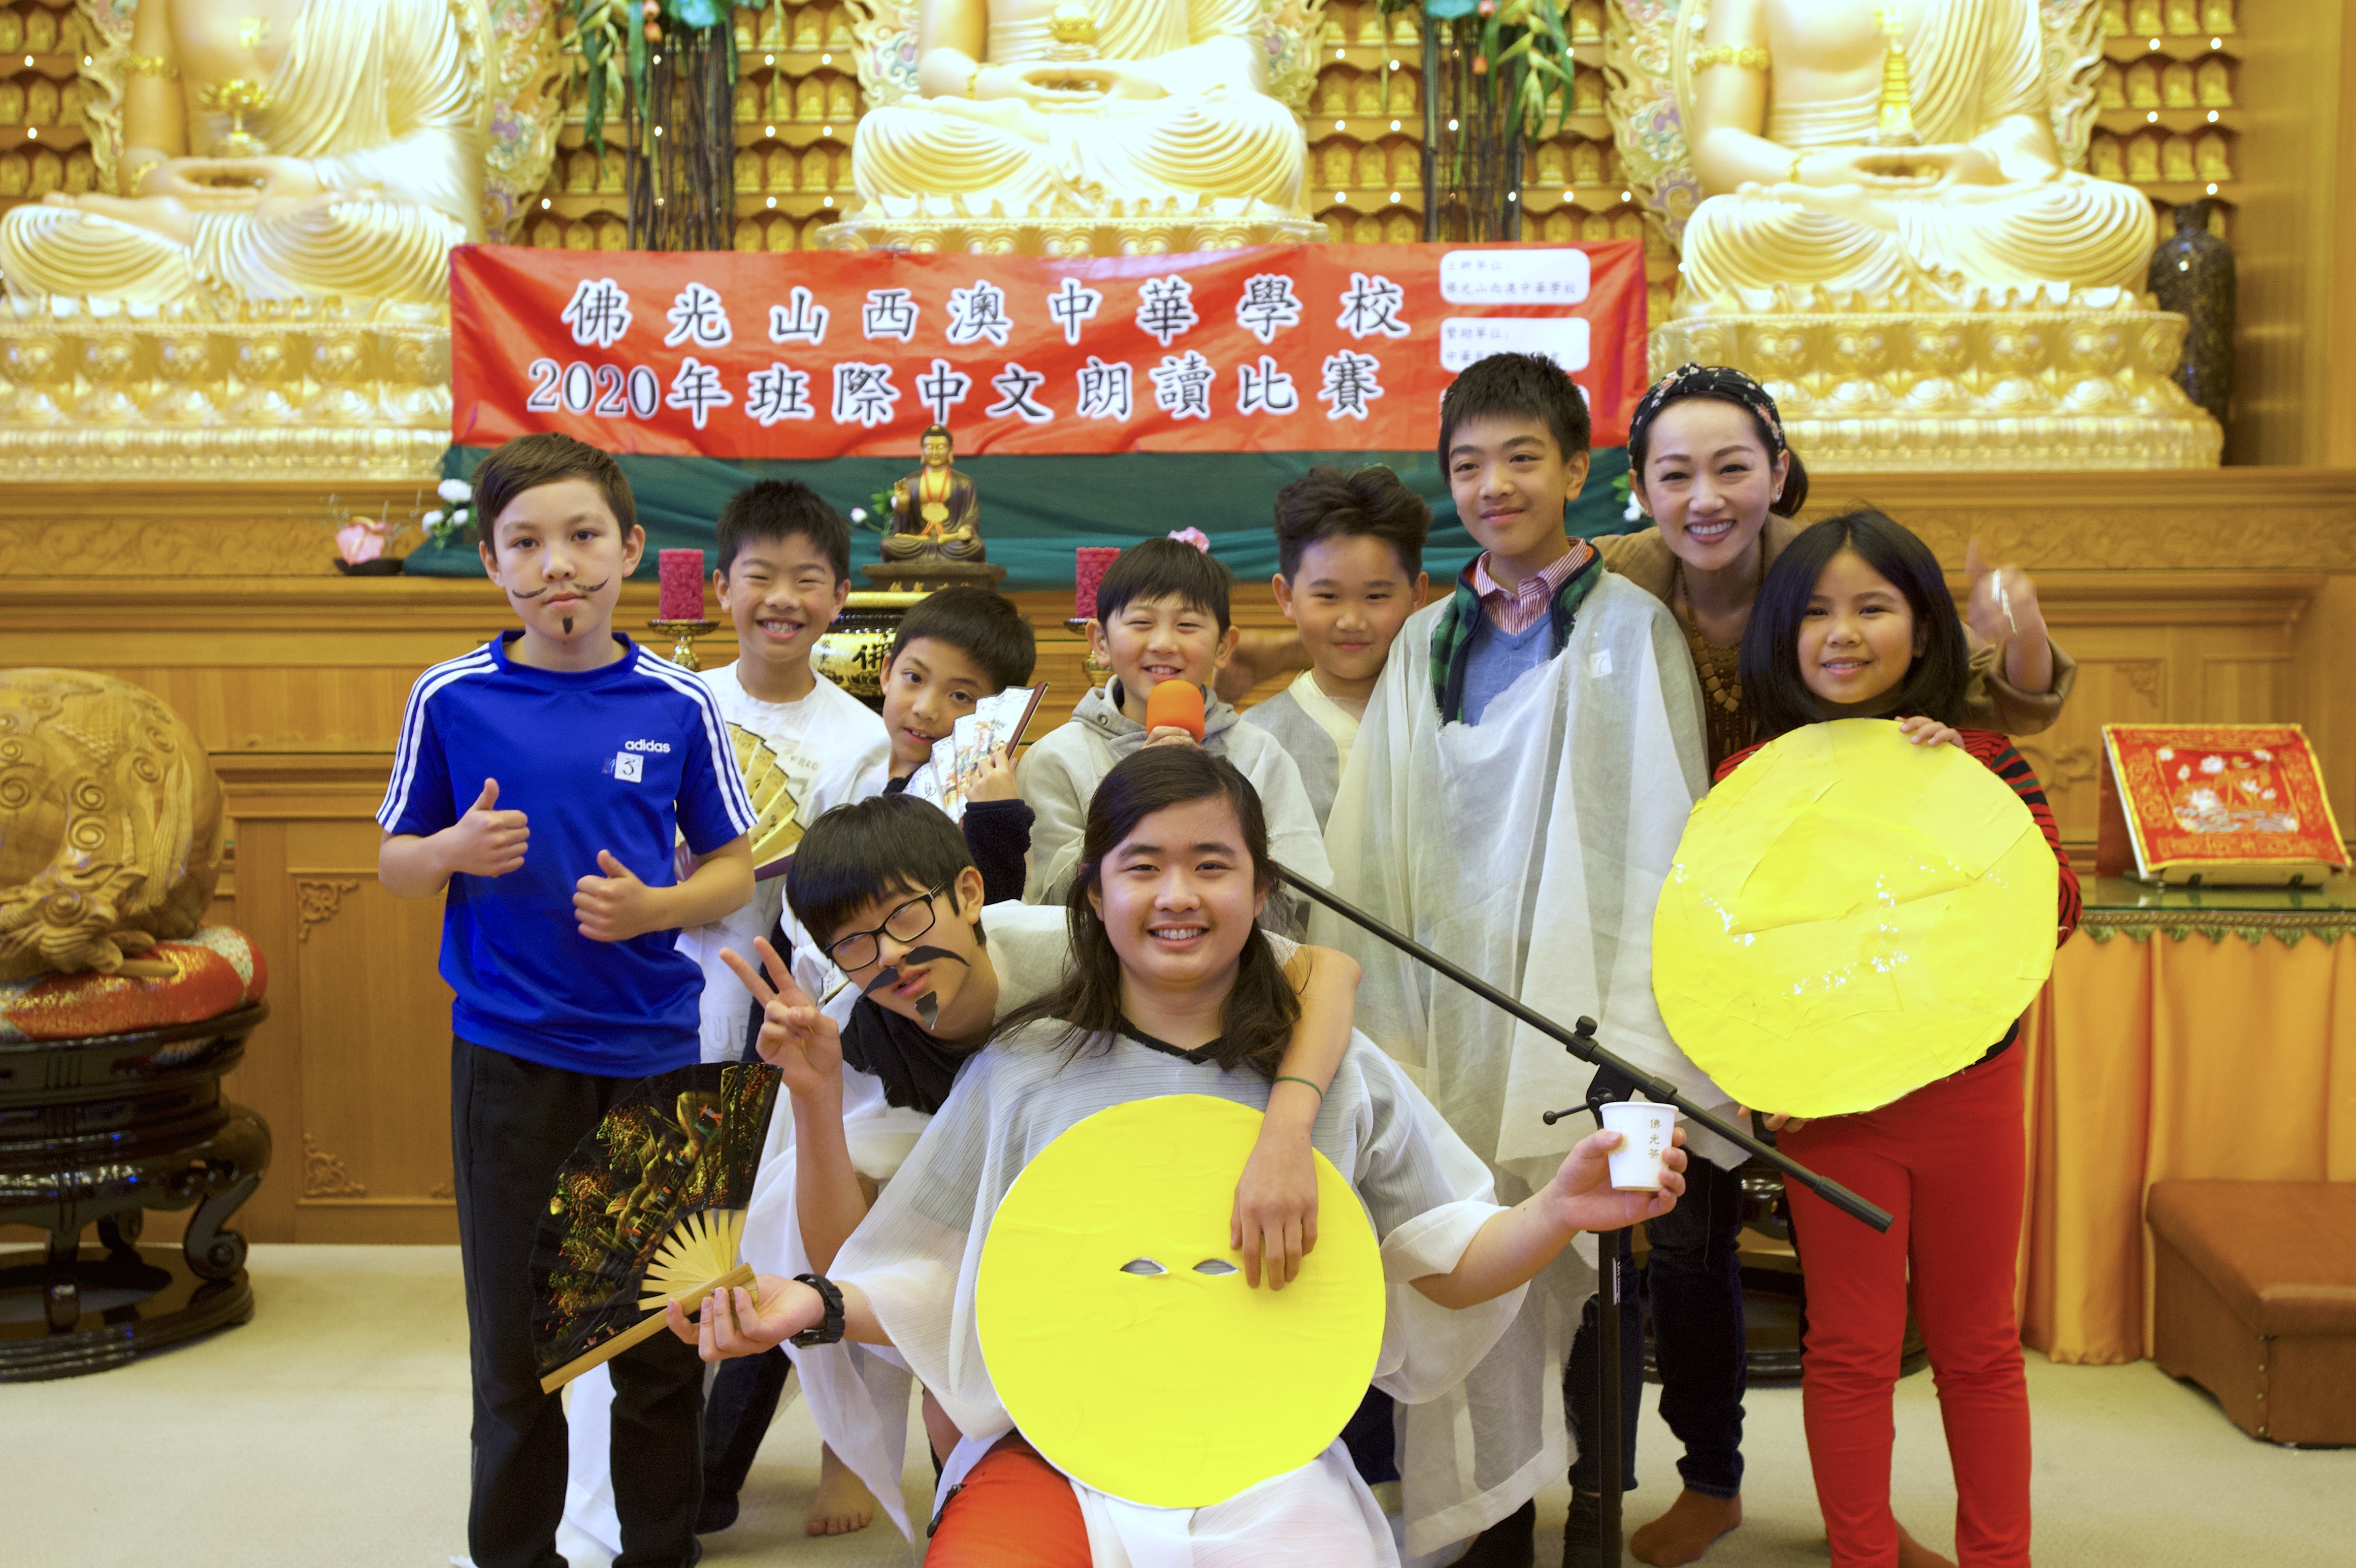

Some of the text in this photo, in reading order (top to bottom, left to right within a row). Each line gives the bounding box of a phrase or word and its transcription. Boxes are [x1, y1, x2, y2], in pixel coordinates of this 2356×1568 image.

[562, 272, 1411, 347] 佛光山西澳中華學校
[527, 350, 1384, 430] 2020年班際中文朗讀比賽
[625, 739, 671, 753] adidas
[1649, 1119, 1661, 1159] 佛光茶
